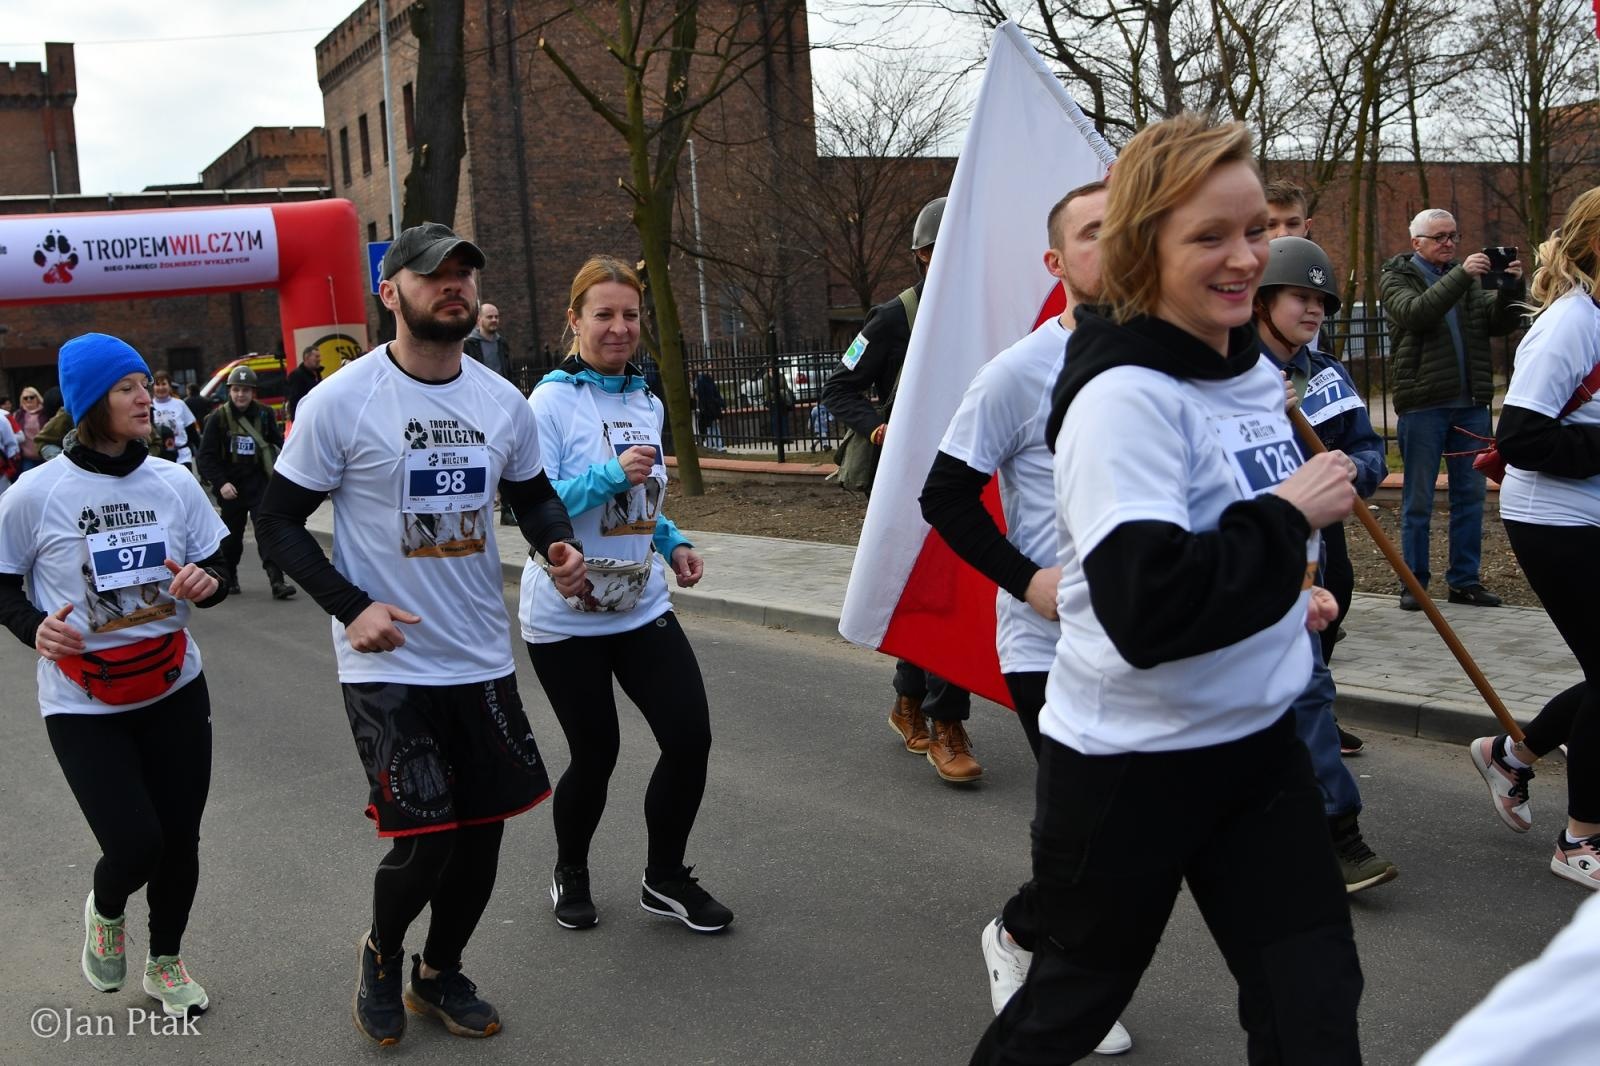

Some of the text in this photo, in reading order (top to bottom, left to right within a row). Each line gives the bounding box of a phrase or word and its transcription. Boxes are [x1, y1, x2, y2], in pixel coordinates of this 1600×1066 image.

[104, 264, 123, 272] BIEG
[1315, 381, 1342, 404] 77
[429, 419, 459, 429] TROPEM
[432, 429, 485, 445] WILCZYM
[442, 456, 469, 465] WILCZYM
[1255, 443, 1298, 482] 126
[435, 470, 466, 494] 98
[101, 503, 130, 514] TROPEM
[104, 510, 157, 527] WILCZYM
[120, 533, 148, 543] WILCZYM
[118, 546, 147, 570] 97
